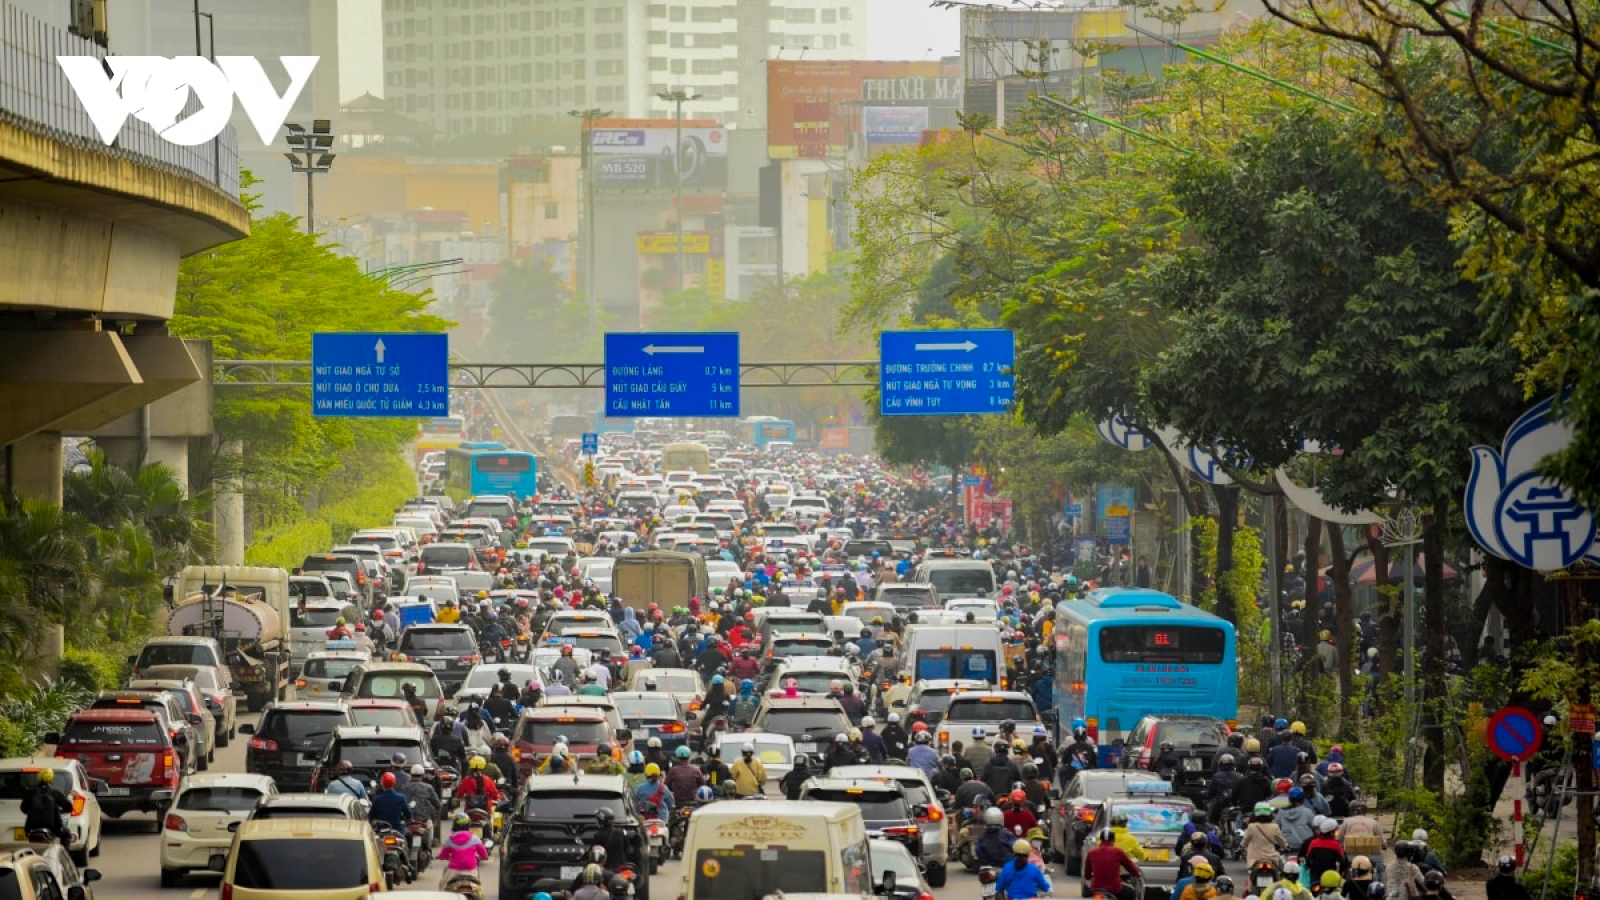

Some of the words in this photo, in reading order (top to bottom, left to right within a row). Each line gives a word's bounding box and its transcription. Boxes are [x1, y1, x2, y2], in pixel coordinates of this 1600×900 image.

[602, 163, 621, 173] MB
[624, 163, 646, 173] 520
[315, 363, 331, 376] NÚT
[334, 366, 353, 376] GIAO
[355, 363, 371, 376] NGÃ
[642, 364, 664, 376] LÁNG
[705, 366, 717, 376] 0,7
[719, 366, 732, 376] km
[950, 362, 974, 373] CHINH
[996, 362, 1010, 373] km
[315, 380, 331, 393] NÚT
[334, 382, 352, 393] GIAO
[364, 383, 380, 395] CHỢ
[417, 383, 429, 393] 2,5
[432, 383, 445, 393] km
[612, 381, 628, 393] NÚT
[630, 383, 649, 393] GIAO
[651, 380, 667, 393] CẦU
[669, 379, 688, 393] GIẤY
[712, 383, 717, 393] 5
[719, 383, 733, 393] km
[886, 378, 901, 391] NÚT
[903, 380, 922, 390] GIAO
[924, 378, 940, 390] NGÃ
[955, 379, 977, 391] VỌNG
[989, 379, 995, 389] 3
[996, 379, 1010, 389] km
[334, 396, 353, 409] MIẾU
[356, 396, 376, 409] QUỐC
[393, 398, 412, 409] GIÁM
[418, 400, 430, 409] 4,3
[432, 399, 445, 409] km
[710, 399, 717, 410] 11
[719, 400, 733, 410] km
[997, 395, 1010, 405] km
[1155, 632, 1170, 644] 01
